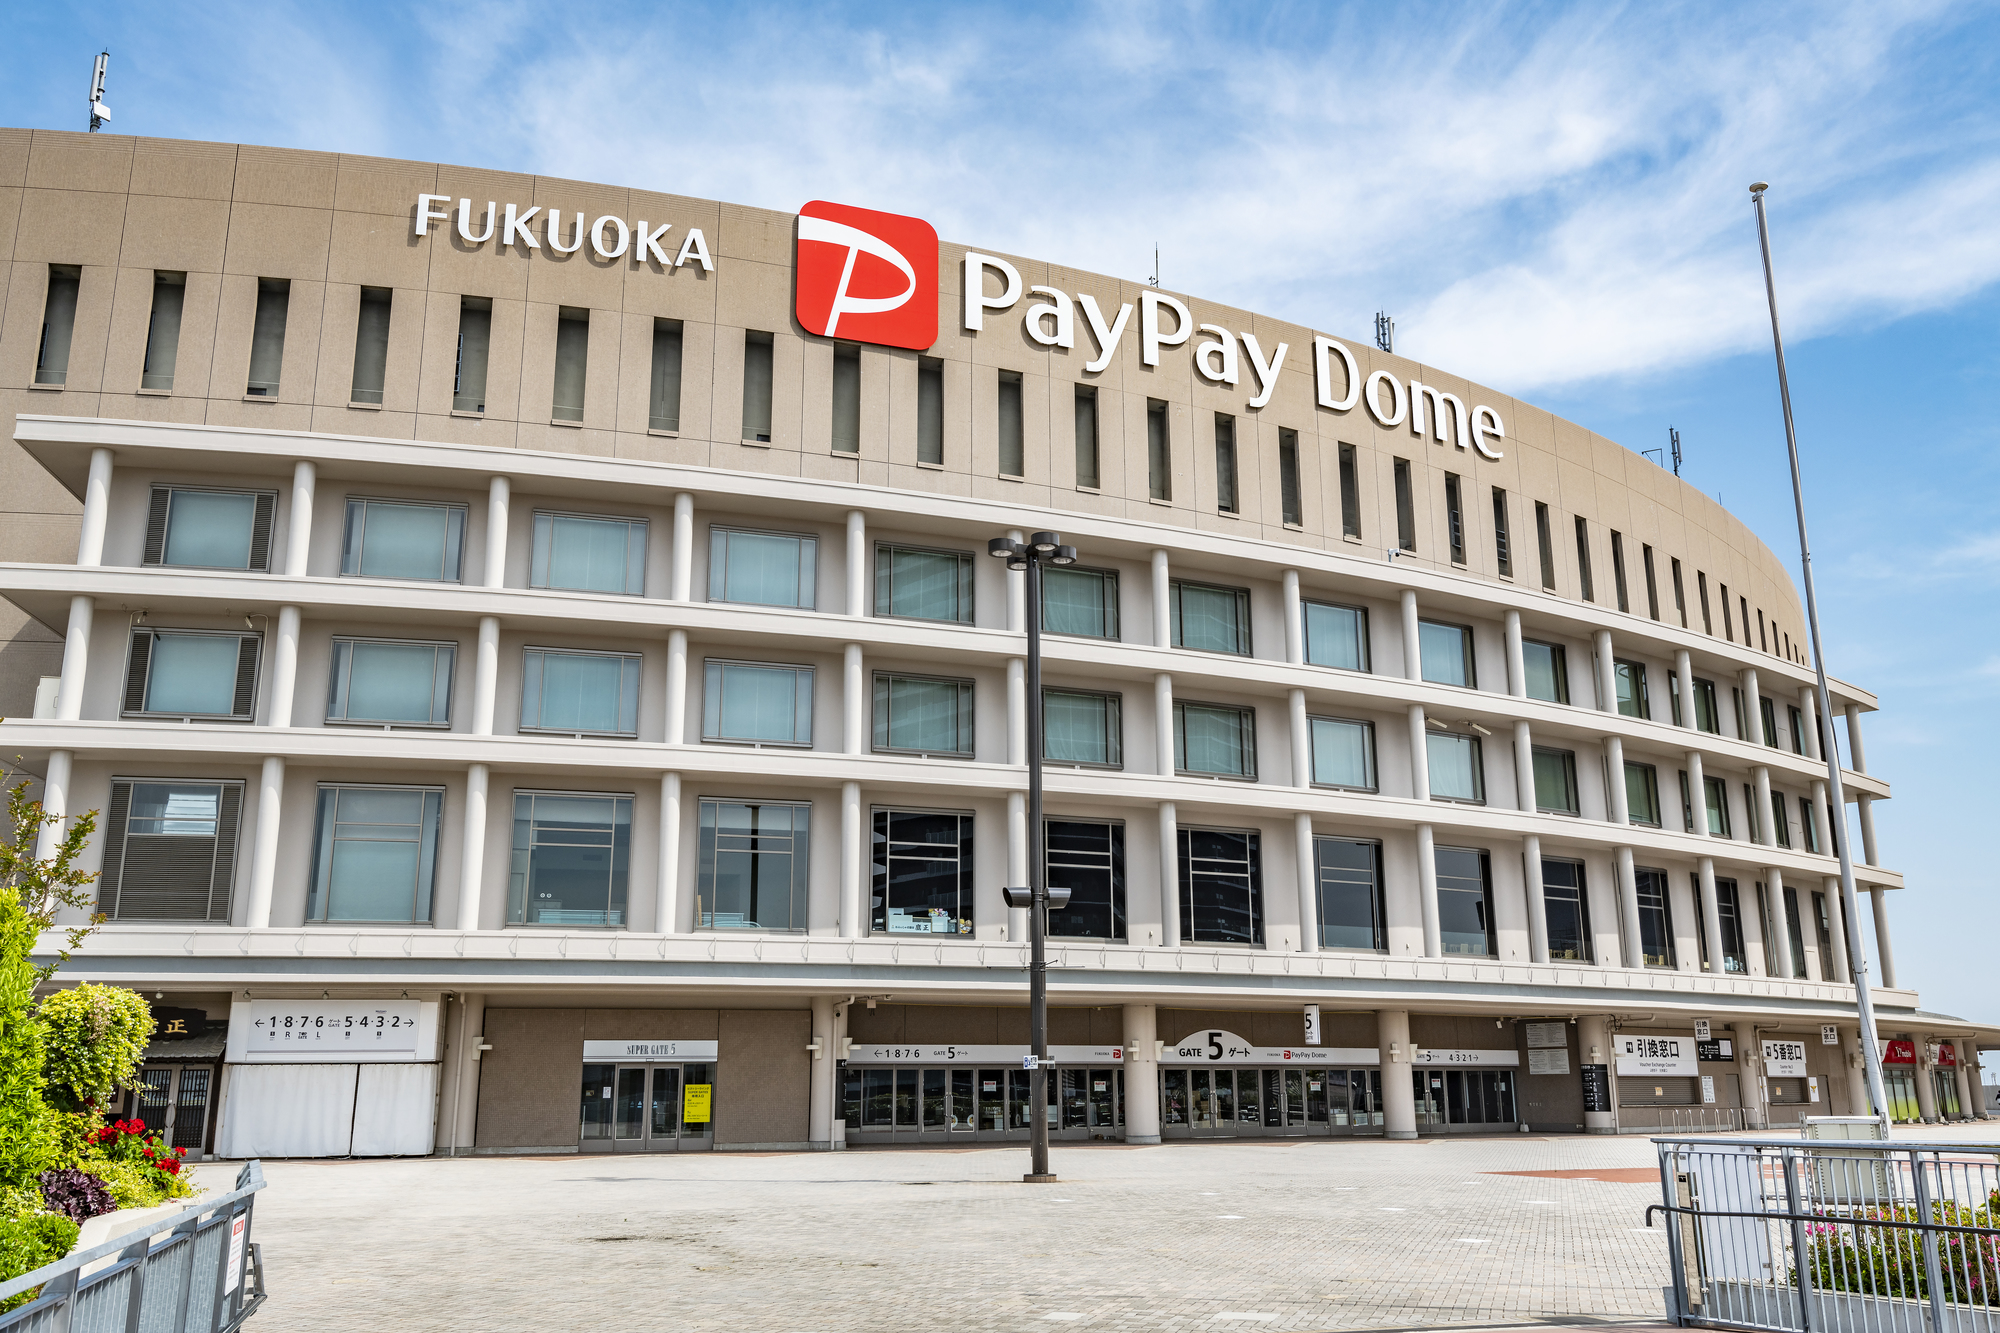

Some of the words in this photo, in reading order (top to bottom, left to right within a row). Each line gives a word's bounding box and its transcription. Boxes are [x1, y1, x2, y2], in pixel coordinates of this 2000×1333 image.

[415, 194, 714, 271] FUKUOKA
[965, 251, 1288, 408] PayPay
[1315, 335, 1505, 459] Dome
[1305, 1013, 1312, 1029] 5
[627, 1045, 649, 1055] SUPER
[651, 1045, 669, 1054] GATE
[671, 1043, 676, 1055] 5
[947, 1046, 955, 1059] 5
[1179, 1048, 1202, 1057] GATE
[1208, 1032, 1223, 1060] 5
[1228, 1047, 1250, 1057] ゲート
[1637, 1039, 1680, 1058] 引換窓口
[1773, 1043, 1803, 1061] 5番窓口
